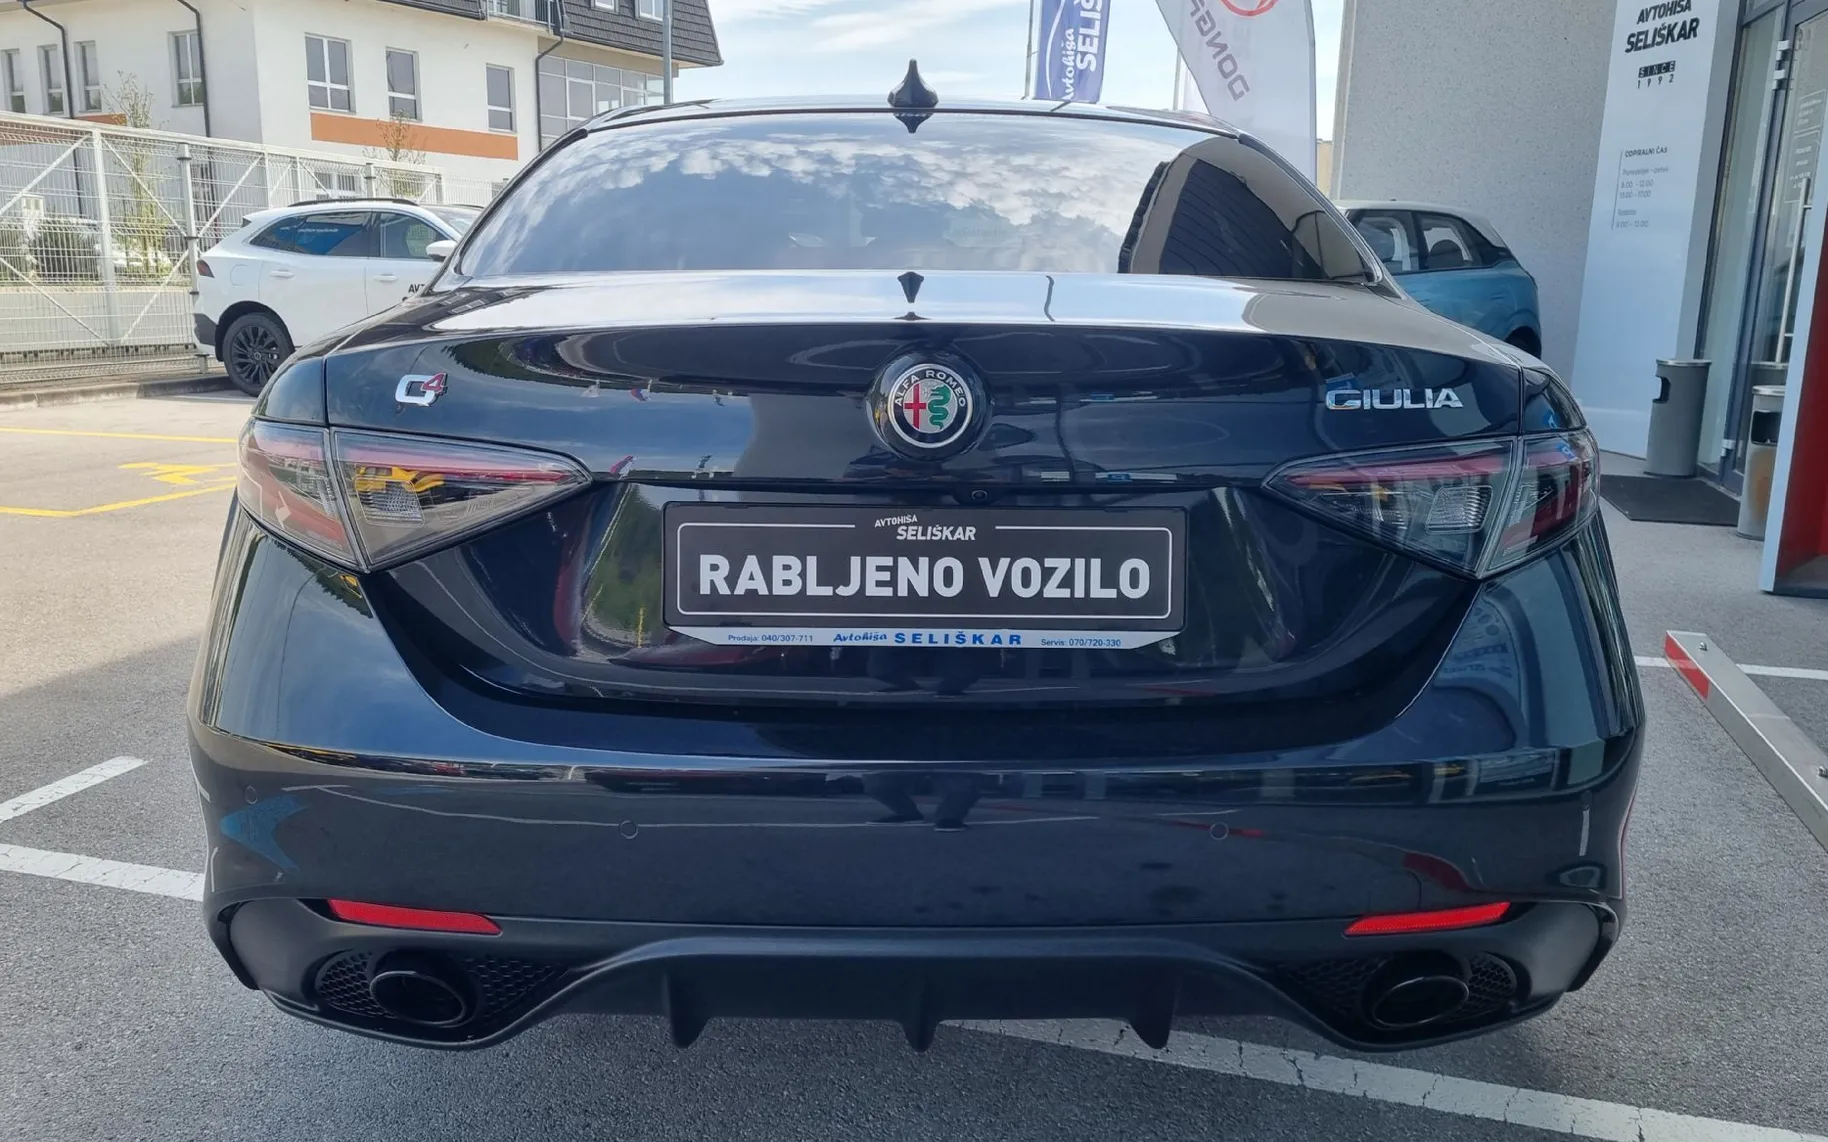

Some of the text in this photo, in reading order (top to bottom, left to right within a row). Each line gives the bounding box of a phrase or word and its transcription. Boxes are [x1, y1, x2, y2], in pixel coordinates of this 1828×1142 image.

[1625, 17, 1700, 53] SELIŠKAR
[1639, 61, 1676, 78] SINCE
[1637, 74, 1674, 90] 1992
[895, 370, 966, 407] ALFA ROMEO
[1325, 388, 1464, 410] GIULIA
[874, 514, 918, 528] AVTOHIŠA
[896, 524, 976, 541] SELIŠKAR
[699, 554, 1151, 599] RABLJENO VOZILO
[728, 631, 1122, 647] Prodaja: 040/307-711 Avtohiša SELIŠKAR Servis: 070/720-330
